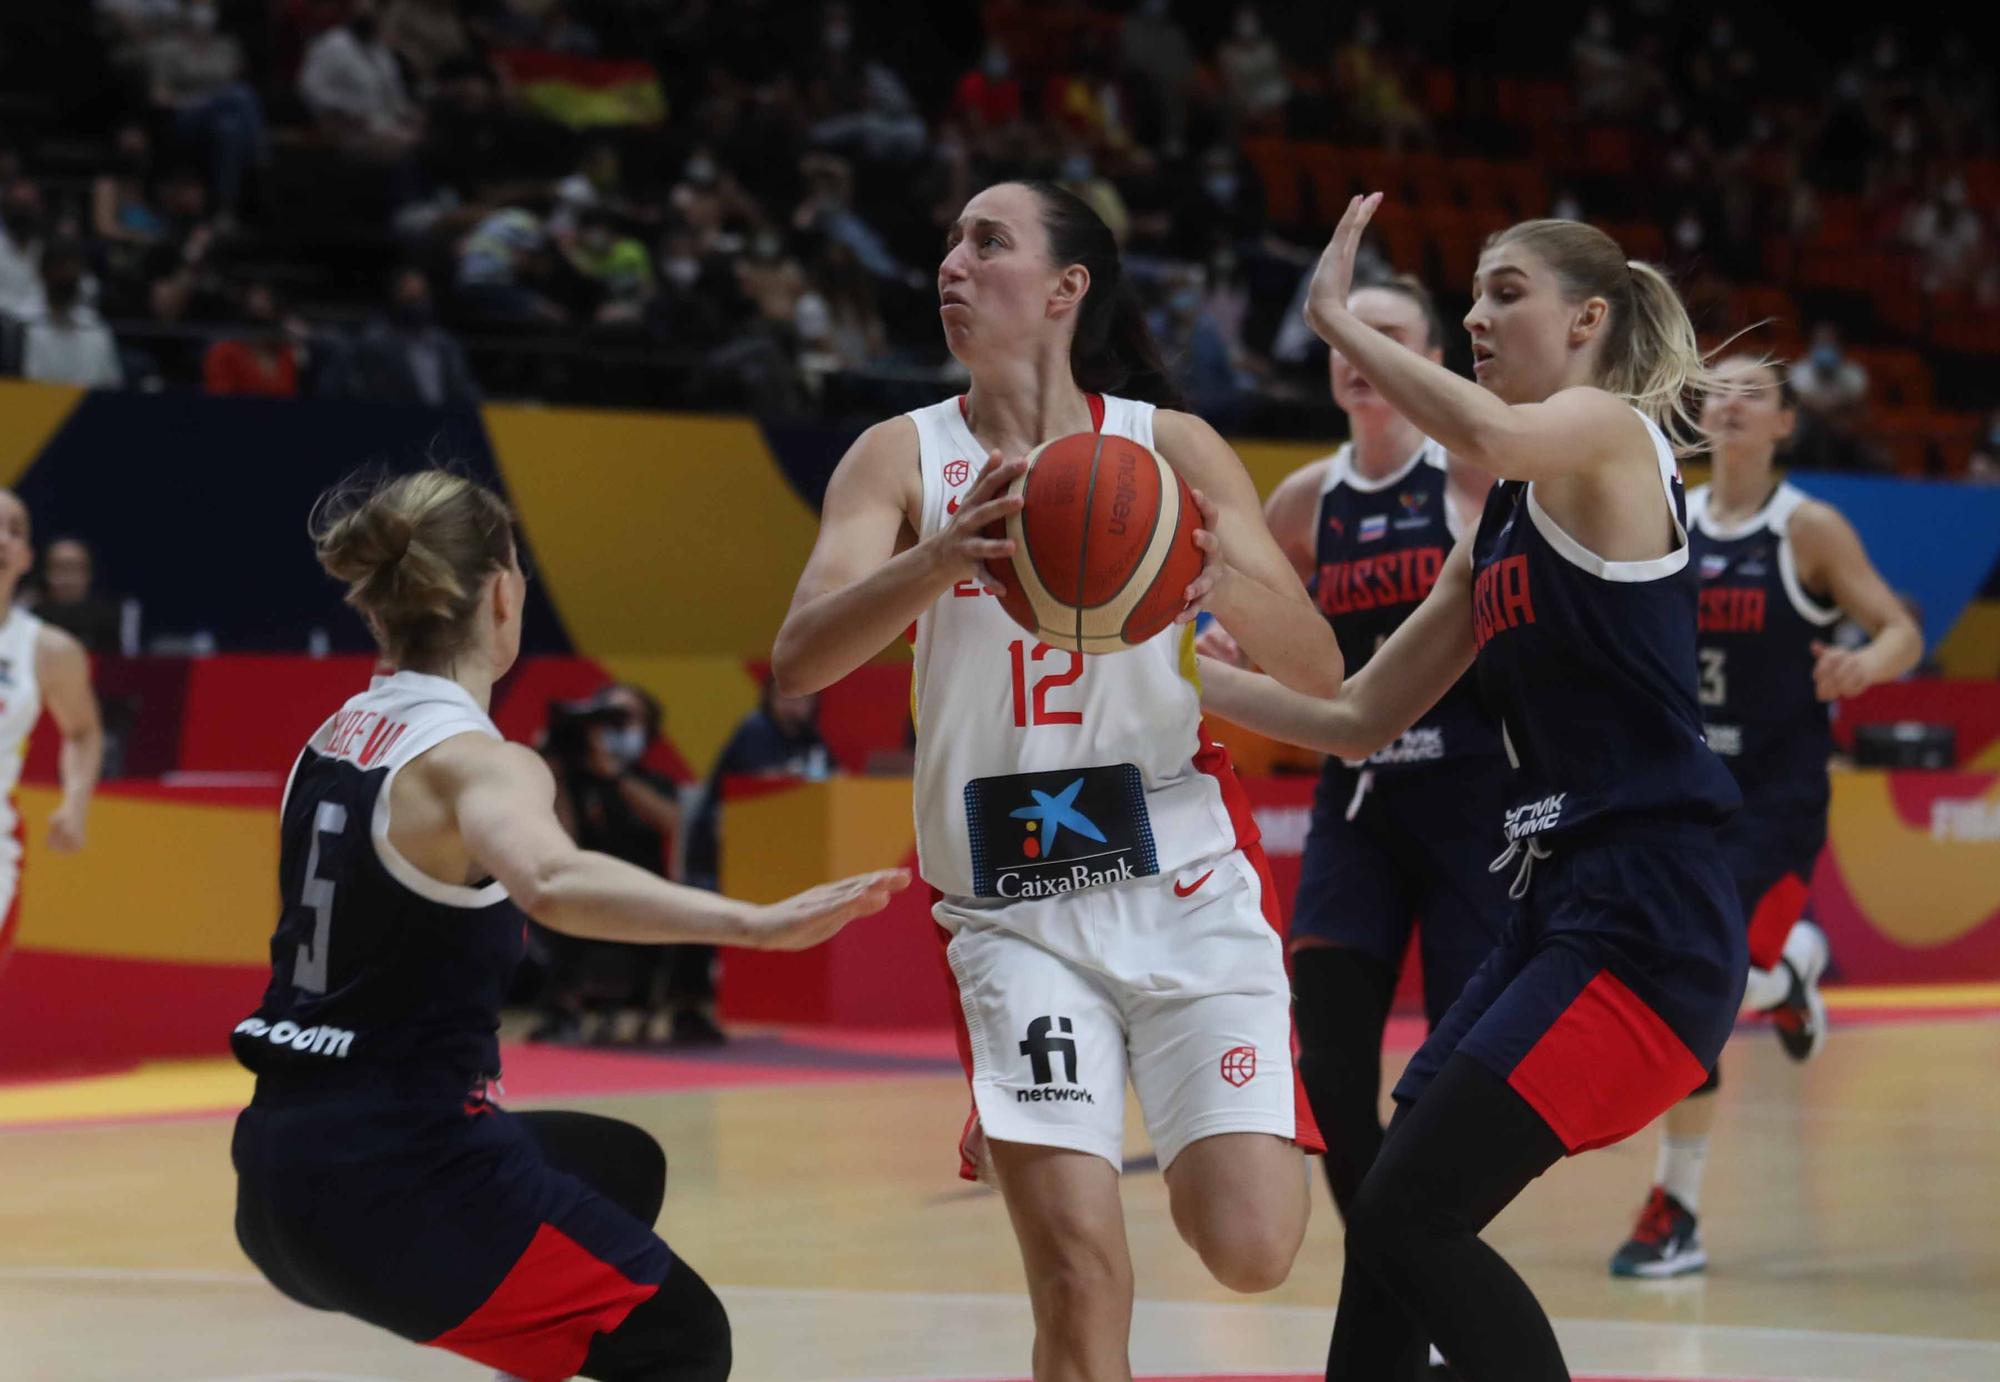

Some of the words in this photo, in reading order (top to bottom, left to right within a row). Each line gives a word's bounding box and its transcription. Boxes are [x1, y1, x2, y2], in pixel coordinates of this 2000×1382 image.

[1108, 451, 1136, 537] molten
[1318, 547, 1445, 616] RUSSIA
[1697, 586, 1767, 633] SSIA
[1009, 641, 1083, 727] 12
[292, 800, 348, 994] 5
[996, 857, 1136, 898] CaixaBank
[1019, 1016, 1077, 1084] fi
[1017, 1086, 1094, 1104] network
